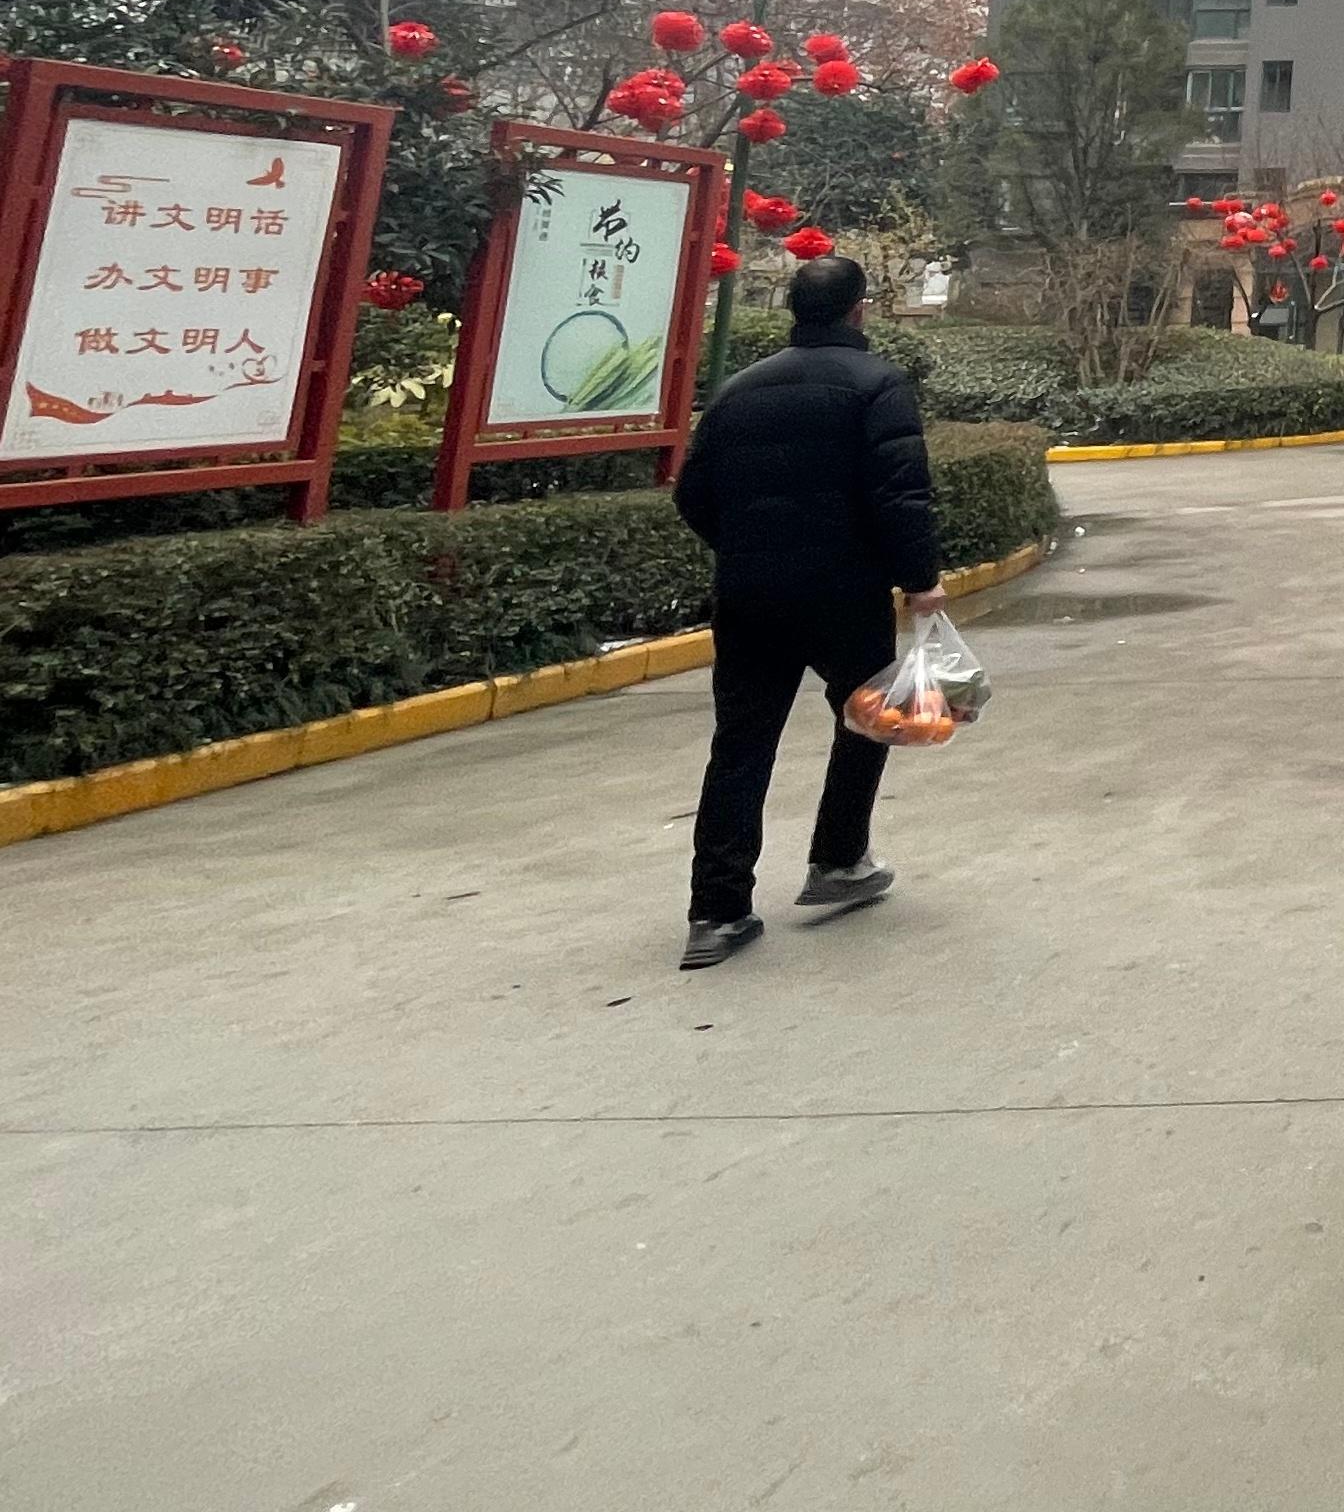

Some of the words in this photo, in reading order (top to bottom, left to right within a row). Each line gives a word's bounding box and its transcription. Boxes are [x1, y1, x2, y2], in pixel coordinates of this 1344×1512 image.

[102, 200, 289, 235] 讲文明话
[584, 199, 640, 306] 节约粮食
[84, 262, 280, 294] 办文明事
[75, 327, 266, 355] 做文明人
